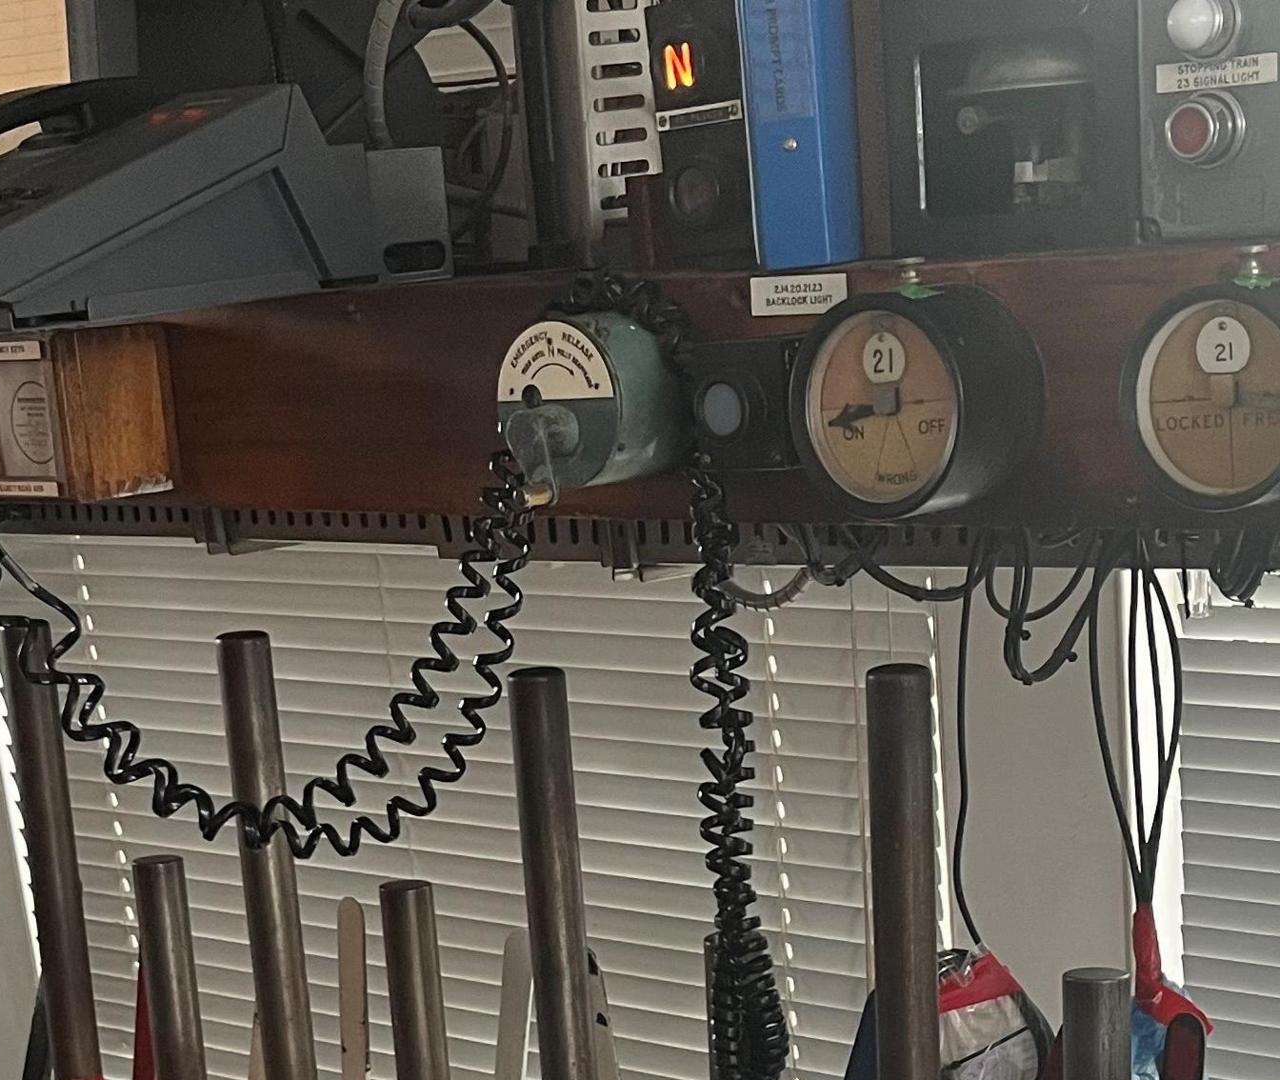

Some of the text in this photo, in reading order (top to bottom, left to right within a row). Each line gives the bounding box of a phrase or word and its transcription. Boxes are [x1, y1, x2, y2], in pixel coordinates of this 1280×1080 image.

[665, 42, 695, 90] N
[1231, 56, 1259, 69] TRAIN
[1177, 71, 1260, 89] 23 SIGNAL LIGHT
[766, 294, 833, 306] BACKLOCK LIGHT
[872, 348, 894, 373] 21
[1215, 342, 1234, 362] 21
[918, 419, 945, 434] OFF
[1154, 414, 1225, 432] LOCKED
